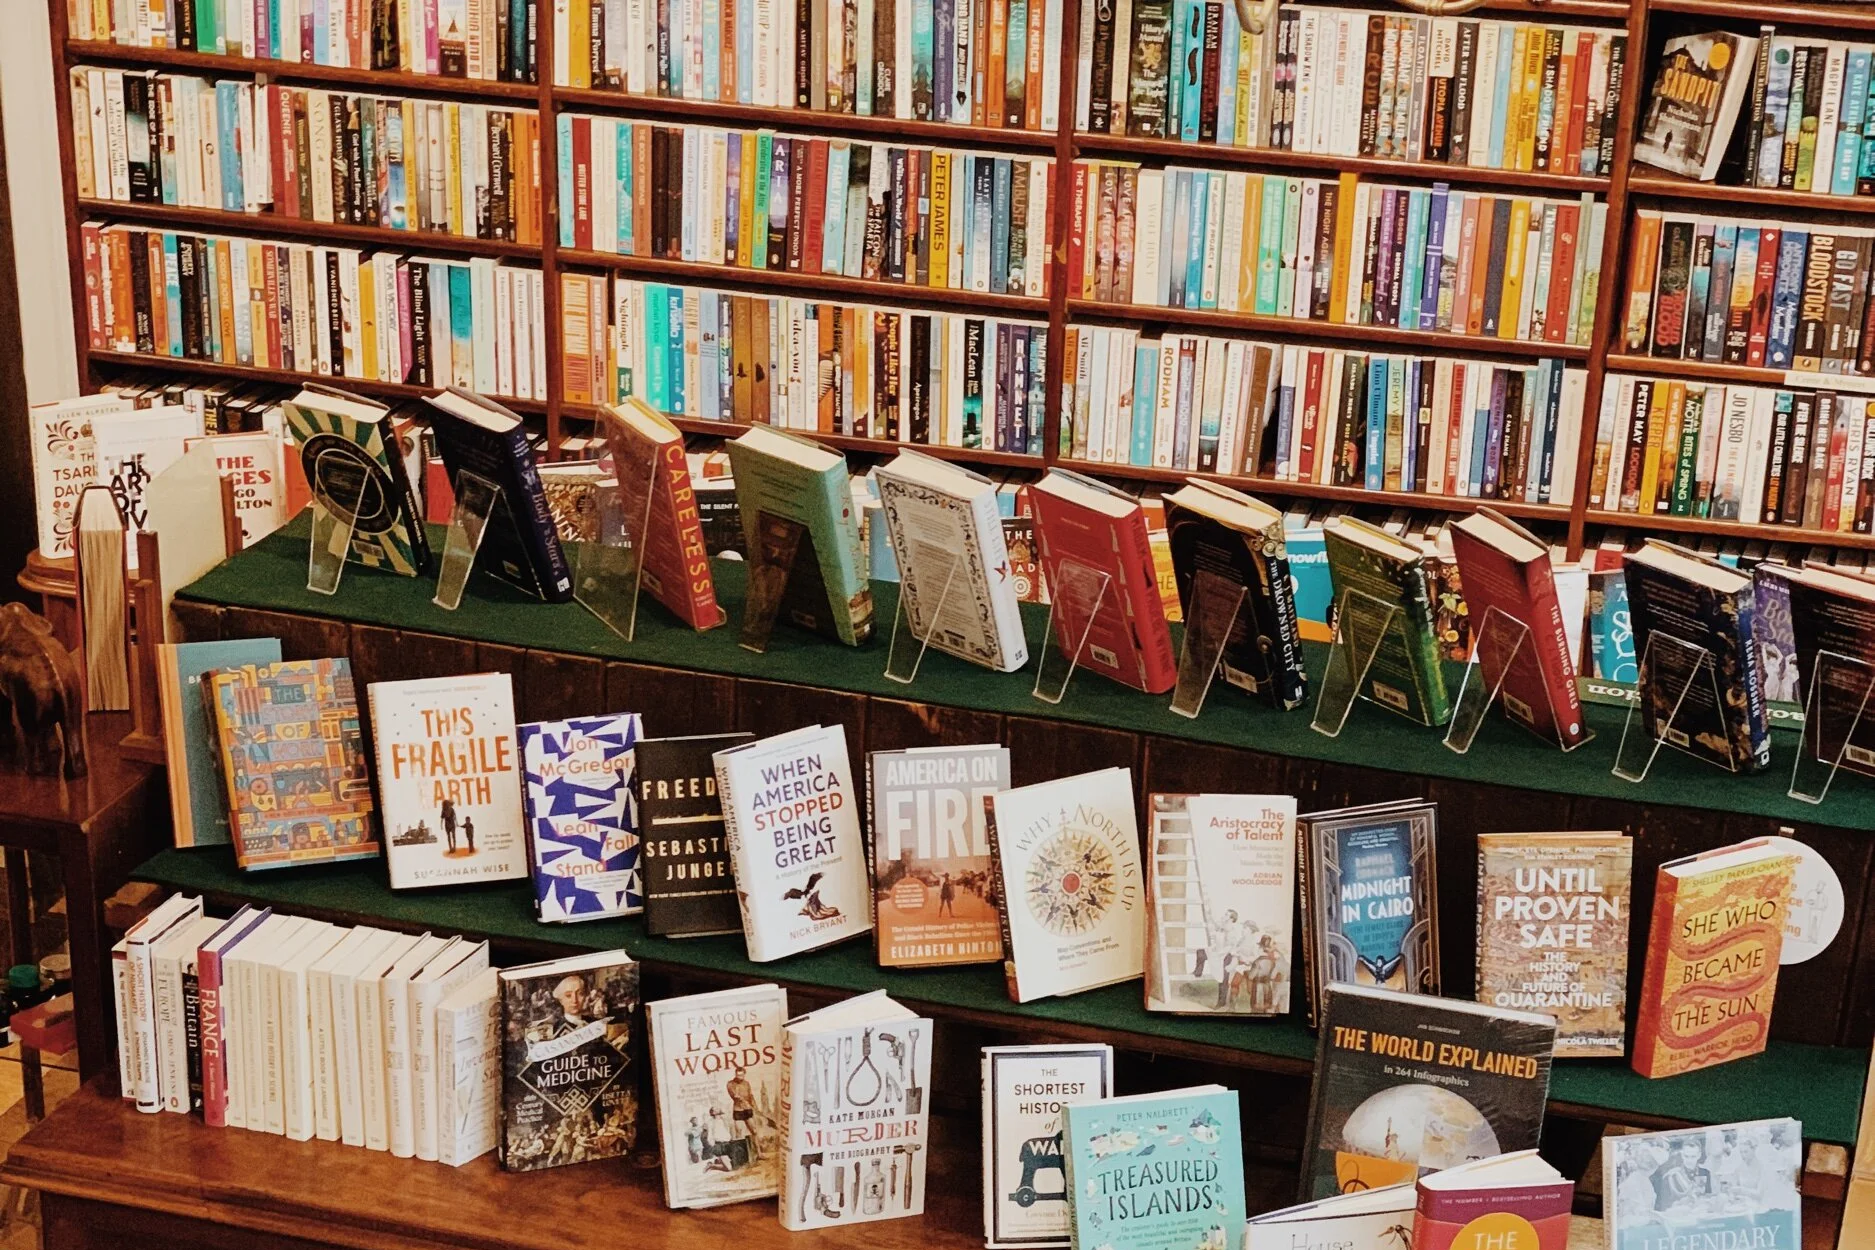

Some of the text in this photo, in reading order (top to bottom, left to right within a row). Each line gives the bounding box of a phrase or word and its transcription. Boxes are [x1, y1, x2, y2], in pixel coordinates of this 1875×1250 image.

[1365, 19, 1383, 105] CIRCE
[1434, 29, 1443, 70] MITCHELL
[1443, 37, 1451, 63] DAVID
[1661, 68, 1722, 109] SANDPIT
[279, 91, 292, 136] QUEENIE
[1432, 79, 1447, 148] UTOPIA AVENUE
[933, 155, 946, 251] PETER JAMES
[1011, 165, 1028, 226] AMBUSH
[1073, 170, 1085, 234] THE THERAPIST
[1802, 235, 1834, 321] BLOODSTOCK
[1829, 250, 1858, 311] GO FAST
[1391, 281, 1400, 306] PEOPLE
[1656, 295, 1672, 346] BLOOD
[1161, 347, 1174, 409] RODHAM
[57, 410, 82, 419] ELLEN
[912, 382, 921, 421] Apeirogon
[1647, 407, 1662, 453] KEEPER
[216, 456, 255, 469] THE
[1844, 458, 1859, 496] RYAN
[665, 443, 710, 596] CARELESS
[1272, 579, 1288, 637] DROWNED
[1283, 639, 1296, 672] CITY
[1550, 605, 1579, 711] THE BURNING GIRLS
[275, 686, 302, 700] THE
[283, 723, 305, 738] OF
[420, 707, 475, 738] THIS
[391, 736, 512, 780] FRAGILE
[569, 737, 599, 753] Jon
[539, 756, 632, 777] McGregor
[761, 754, 823, 785] WHEN
[886, 756, 998, 786] AMERICA ON
[642, 777, 716, 800] FREED
[752, 772, 841, 810] AMERICA
[754, 792, 843, 832] STOPPED
[1209, 816, 1285, 831] Aristocracy
[1260, 808, 1284, 820] The
[555, 822, 599, 837] Lean
[773, 816, 833, 847] BEING
[1226, 829, 1284, 841] of Talent
[605, 835, 635, 851] Fall
[646, 838, 729, 857] SEBASTI
[775, 836, 837, 868] GREAT
[483, 863, 510, 874] WISE
[556, 859, 607, 877] Stand
[1016, 803, 1136, 911] WHY NORTH IS UP
[666, 862, 725, 880] JUNGE
[1514, 867, 1603, 893] UNTIL
[1692, 874, 1724, 887] SHELLEY
[1341, 876, 1411, 901] MIDNIGHT
[1342, 897, 1414, 923] IN CAIRO
[1494, 895, 1620, 921] PROVEN
[1681, 900, 1777, 939] SHE WHO
[790, 915, 848, 940] NICK BRYANT
[1519, 923, 1593, 949] SAFE
[891, 944, 954, 958] ELIZABETH
[1543, 952, 1567, 962] THE
[1529, 961, 1581, 973] HISTORY
[1541, 971, 1568, 983] AND
[1682, 948, 1764, 984] BECAME
[1494, 992, 1613, 1009] QUARANTINE
[1522, 982, 1586, 994] FUTURE OF
[185, 992, 198, 1048] Britain
[200, 989, 219, 1059] FRANCE
[687, 1008, 758, 1029] FAMOUS
[1674, 994, 1760, 1032] THE SUN
[685, 1023, 763, 1053] LAST
[1670, 1049, 1693, 1062] REBEL
[1693, 1039, 1730, 1056] WARRIOR
[541, 1055, 608, 1073] GUIDE TO
[674, 1046, 777, 1077] WORDS
[1333, 1026, 1539, 1081] THE WORLD EXPLAINED
[537, 1065, 612, 1088] MEDICINE
[1041, 1068, 1058, 1077] THE
[1395, 1065, 1412, 1078] 264
[1413, 1069, 1470, 1087] Infographics
[1014, 1082, 1086, 1096] SHORTEST
[829, 1107, 896, 1124] KATE MORGAN
[1019, 1101, 1068, 1114] HISTO
[1116, 1107, 1189, 1123] PETER NALDRETT
[804, 1119, 918, 1148] MURDER
[1044, 1118, 1059, 1134] of
[830, 1146, 891, 1161] THE BIOGRAPHY
[1098, 1159, 1218, 1195] TREASURED
[1108, 1185, 1214, 1222] ISLANDS
[1472, 1231, 1518, 1250] THE
